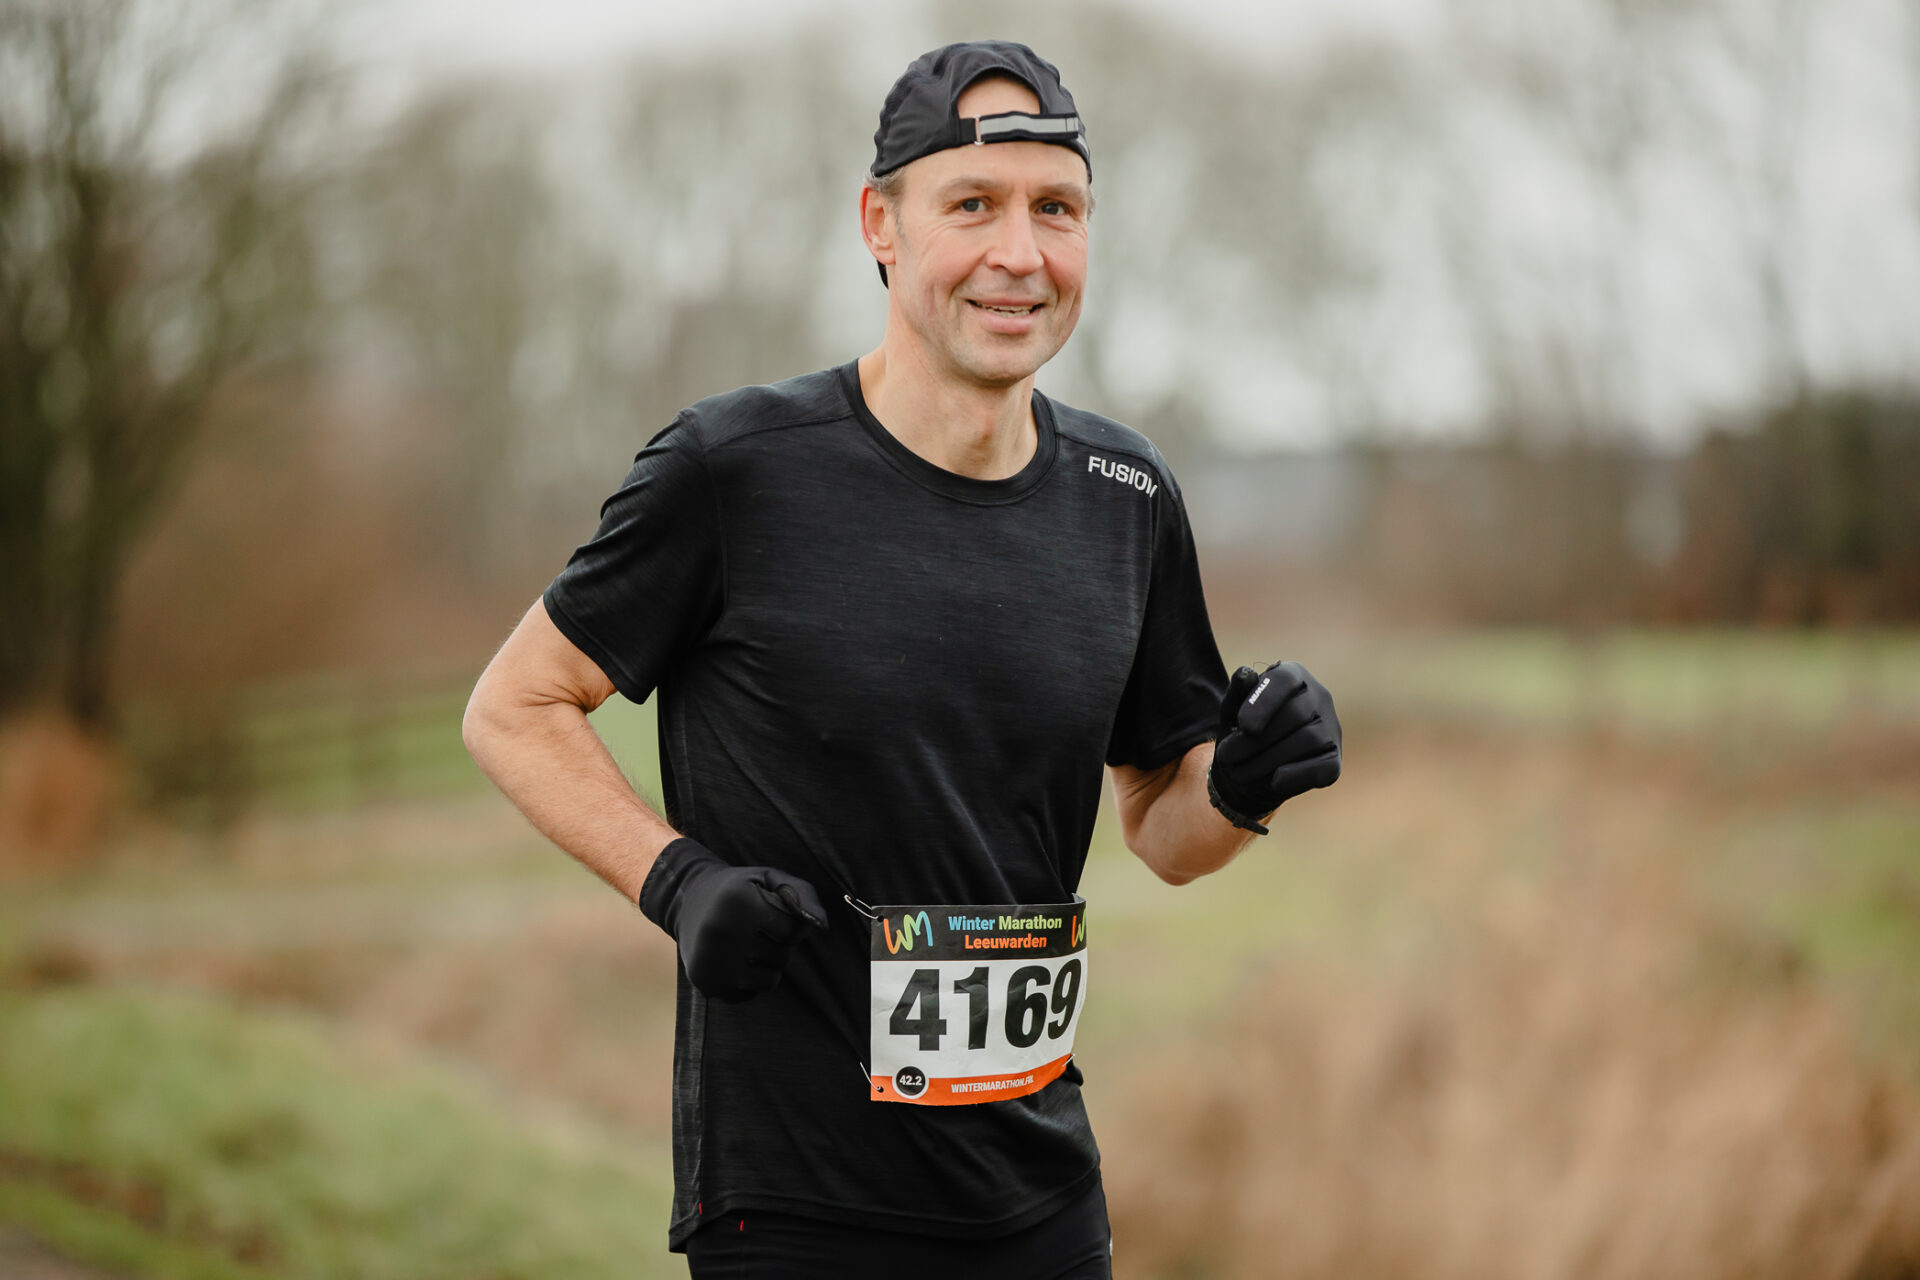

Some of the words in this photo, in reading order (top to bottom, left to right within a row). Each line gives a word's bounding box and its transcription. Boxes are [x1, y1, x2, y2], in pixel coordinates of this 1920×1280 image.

[948, 916, 995, 931] Winter
[998, 915, 1063, 931] Marathon
[964, 933, 1047, 949] Leeuwarden
[889, 958, 1082, 1051] 4169
[899, 1074, 923, 1087] 42.2
